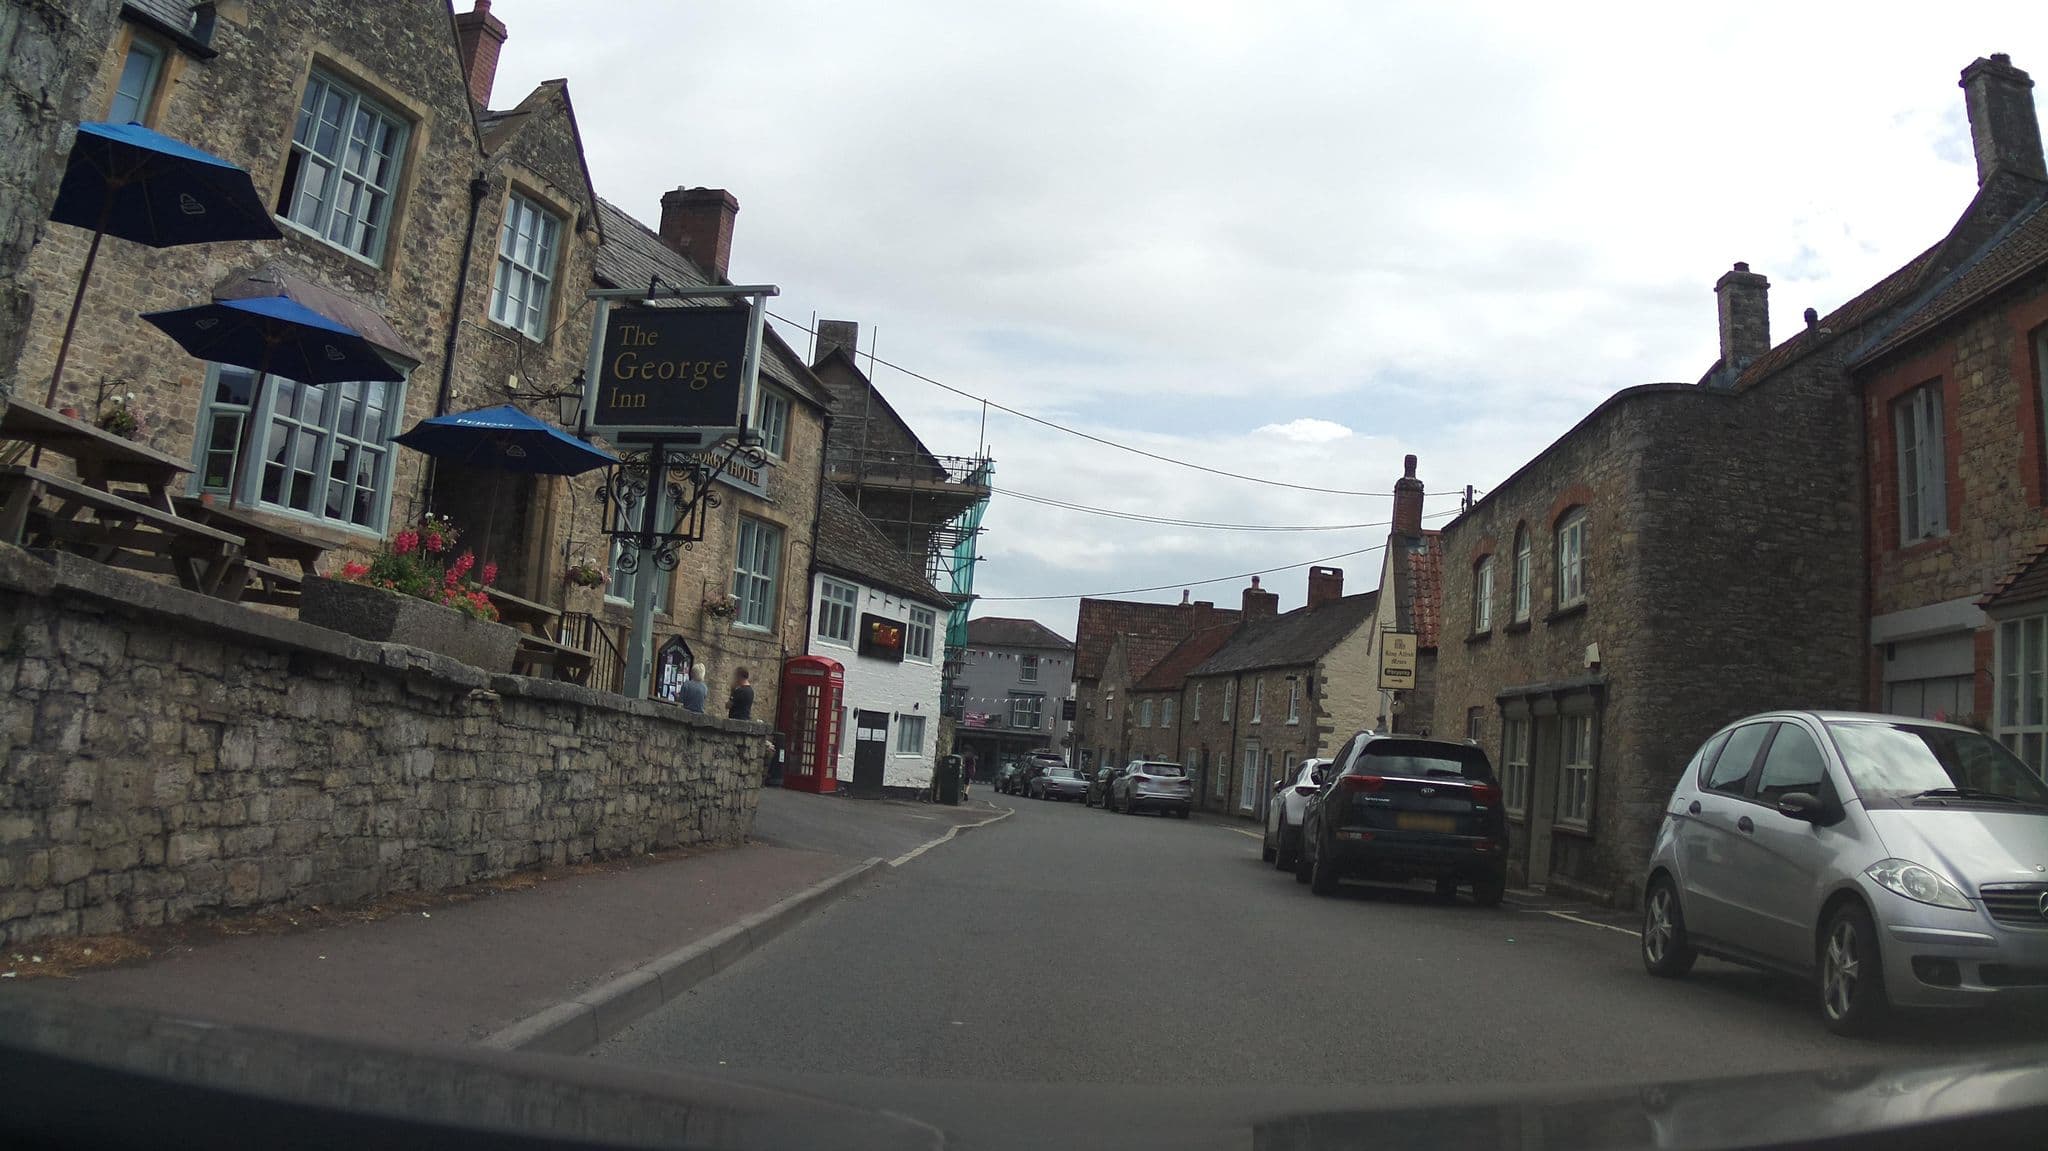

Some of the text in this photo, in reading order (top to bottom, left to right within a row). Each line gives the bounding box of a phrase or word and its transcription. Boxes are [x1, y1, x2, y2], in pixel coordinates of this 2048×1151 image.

[619, 325, 658, 346] The
[613, 351, 729, 390] George
[609, 386, 647, 408] Inn
